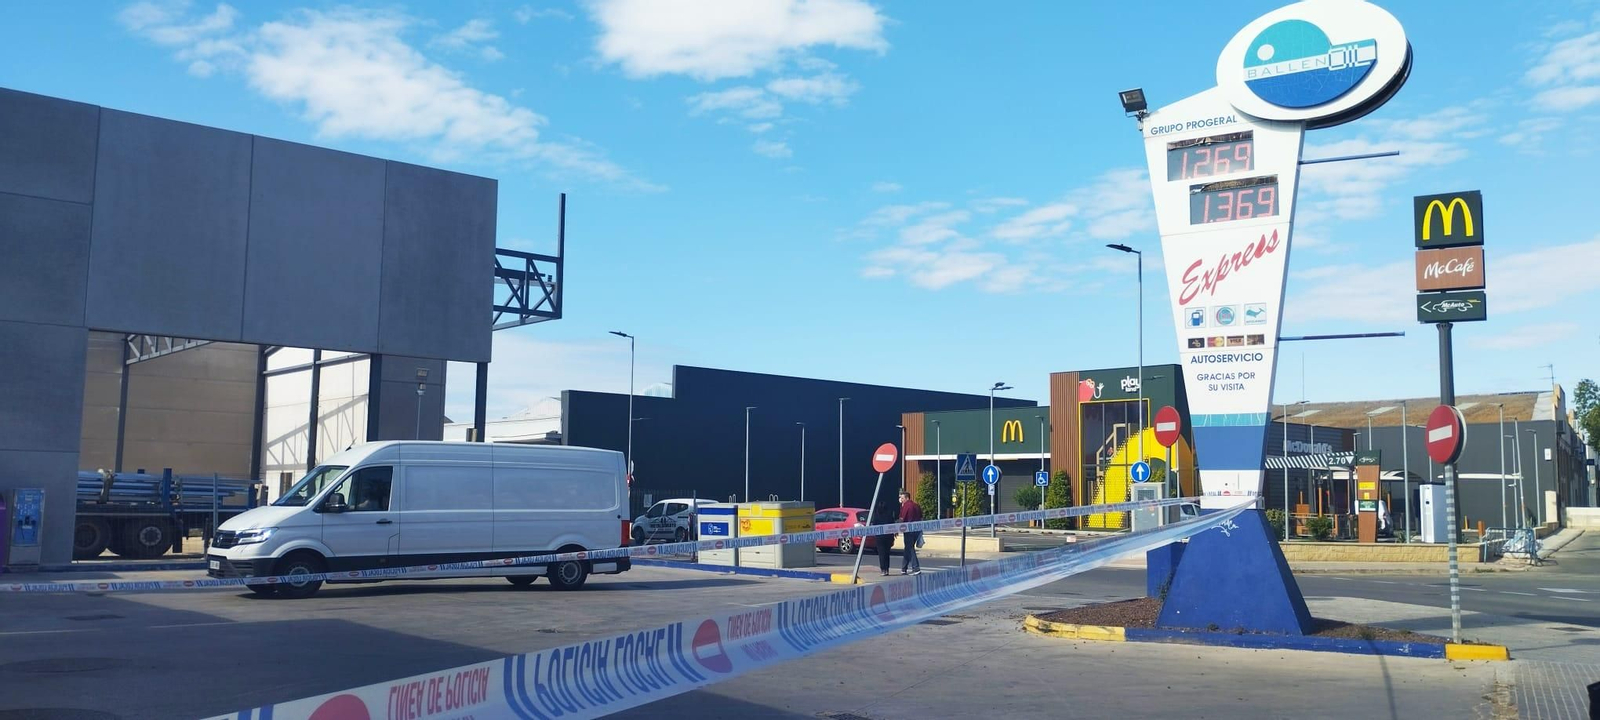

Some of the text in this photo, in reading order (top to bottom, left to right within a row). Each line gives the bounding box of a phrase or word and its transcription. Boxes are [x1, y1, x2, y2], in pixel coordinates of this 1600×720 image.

[1150, 115, 1237, 136] GRUPO PROGERAL
[1181, 143, 1251, 180] 1.269
[1203, 187, 1275, 223] 1.369
[1179, 229, 1280, 305] Express
[1424, 257, 1475, 279] McCafé
[1441, 301, 1465, 309] McAuto
[1190, 353, 1264, 364] AUTOSERVICIO
[1196, 372, 1256, 381] GRACIAS POR
[1220, 383, 1245, 391] VISITA
[1328, 457, 1346, 465] 2.70
